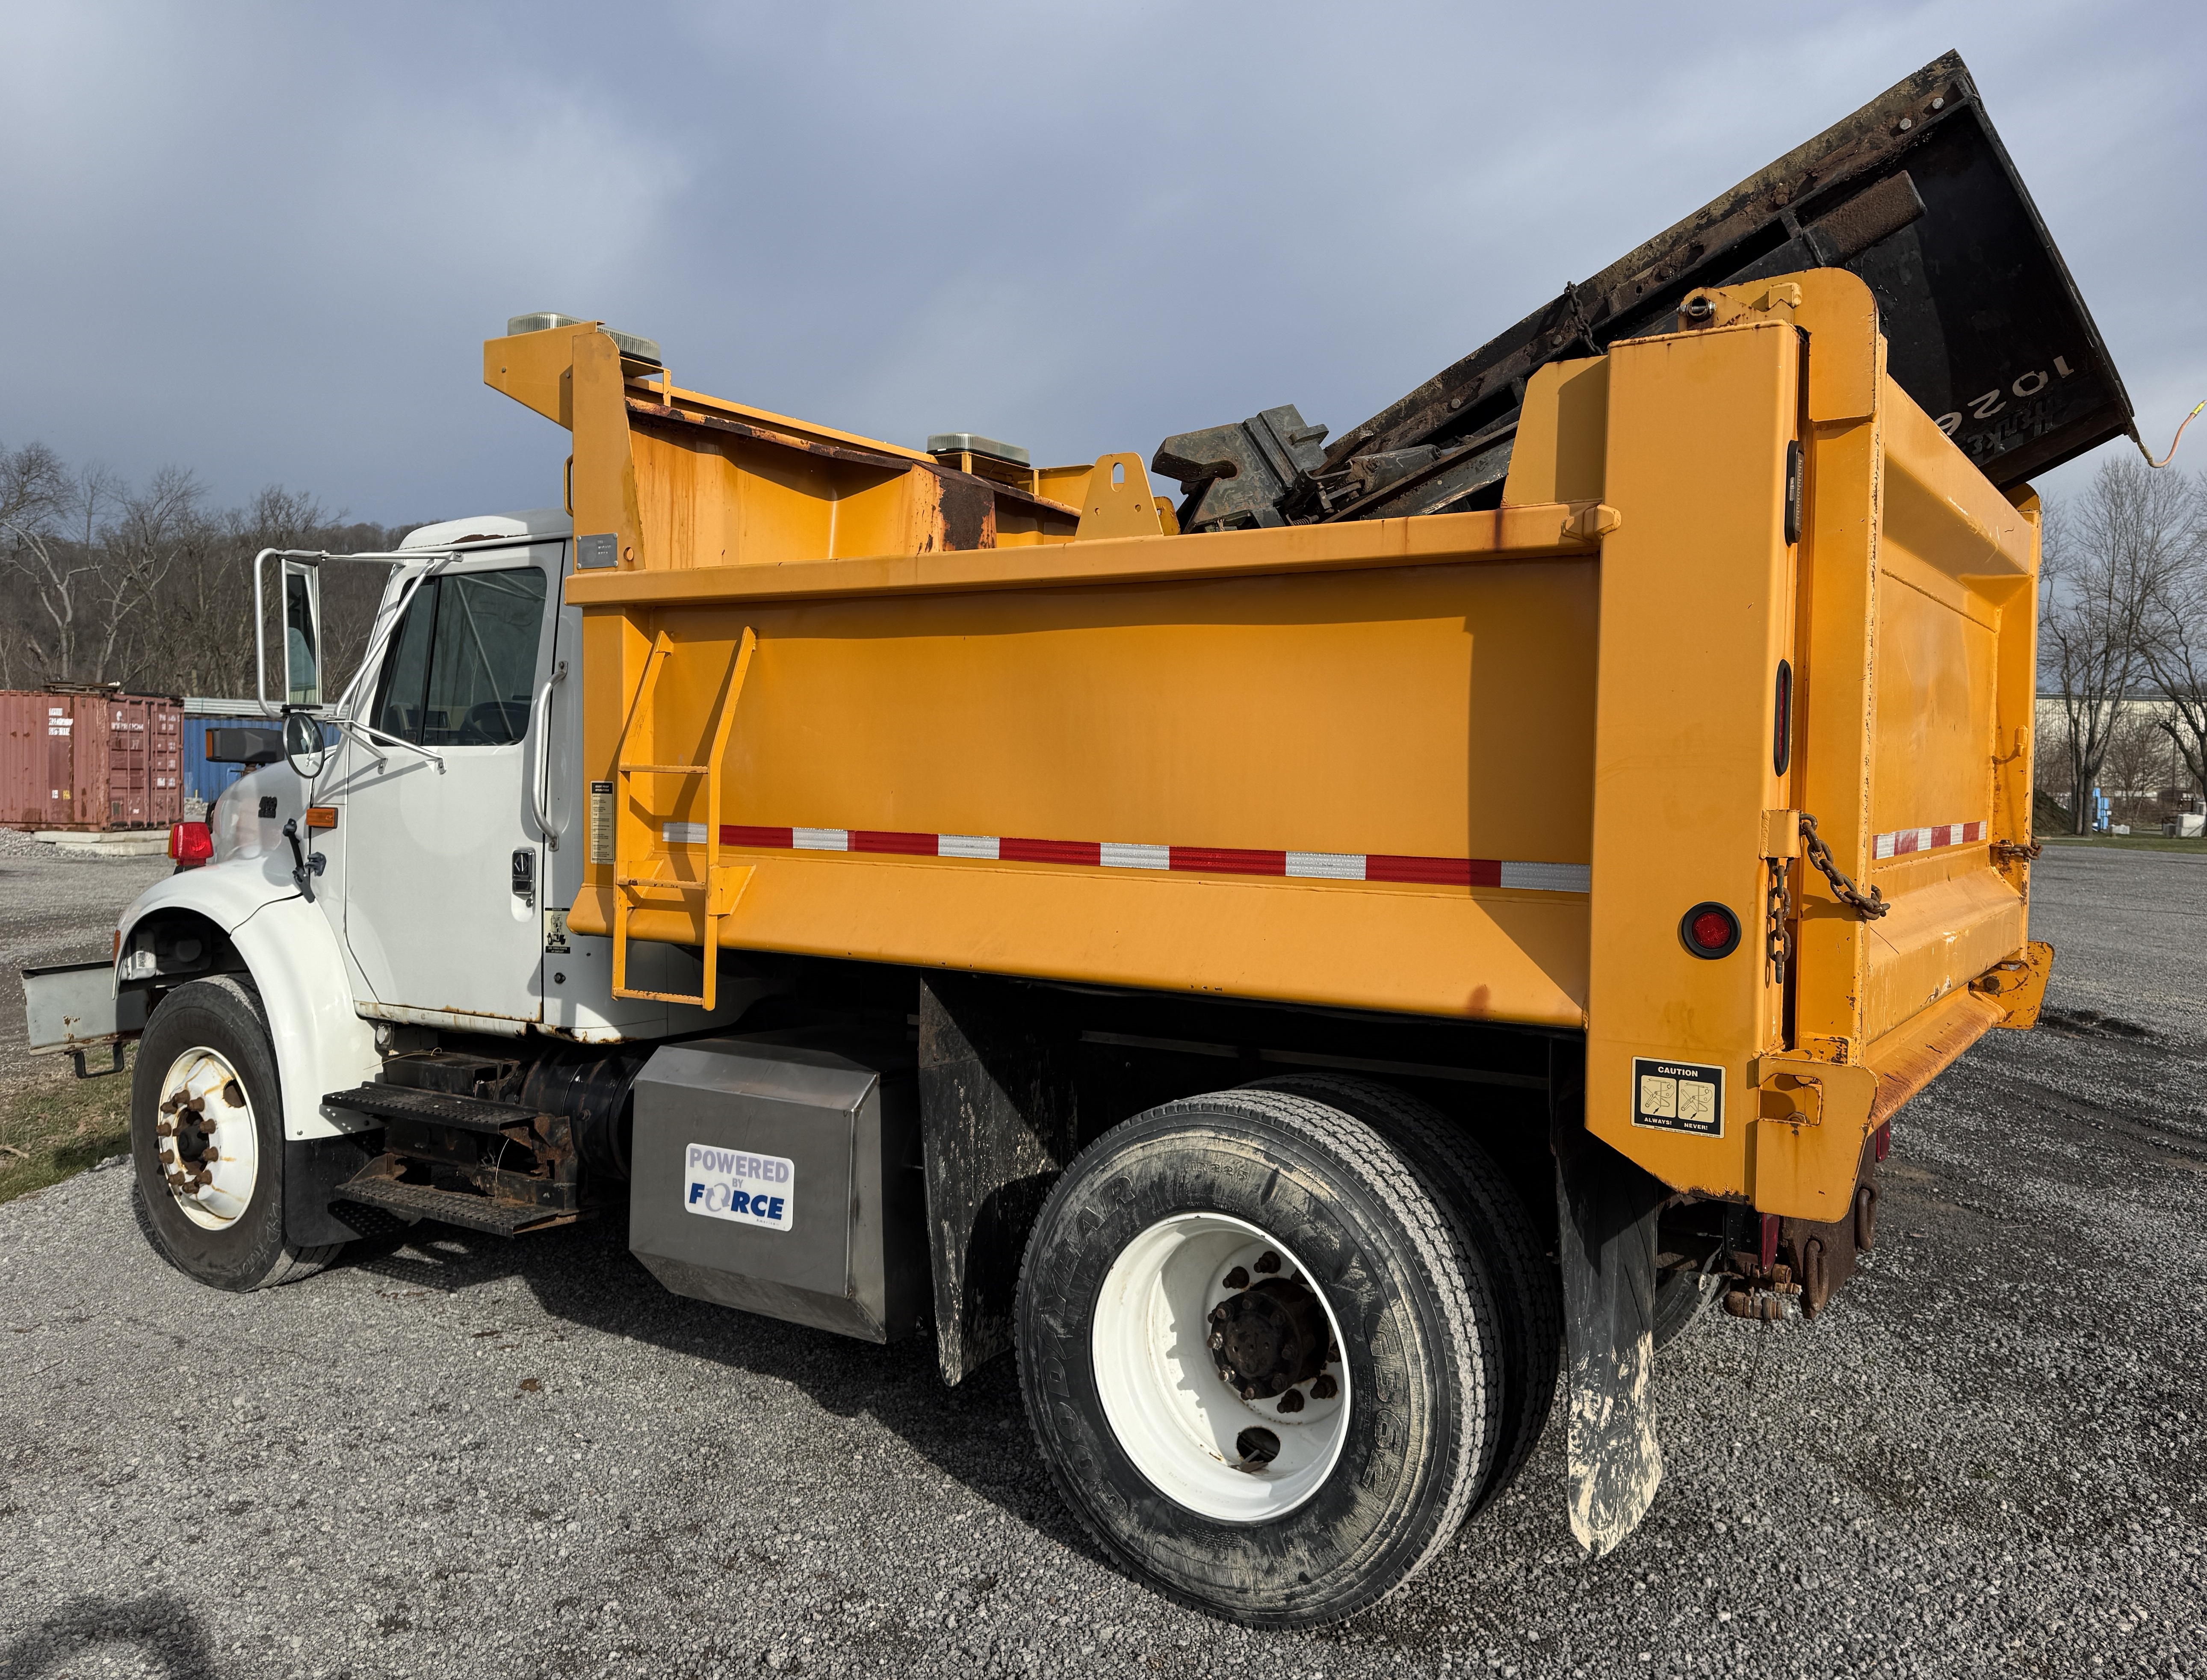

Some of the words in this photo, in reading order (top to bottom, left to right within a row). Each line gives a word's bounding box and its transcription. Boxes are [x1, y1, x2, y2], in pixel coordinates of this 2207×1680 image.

[1657, 1066, 1698, 1077] CAUTION
[1644, 1117, 1672, 1125] ALWAYS!
[690, 1148, 789, 1183] POWERED
[732, 1178, 743, 1188] BY
[689, 1183, 784, 1220] FORCE
[1039, 1176, 1136, 1520] GOODYEAR
[1361, 1312, 1404, 1498] G362
